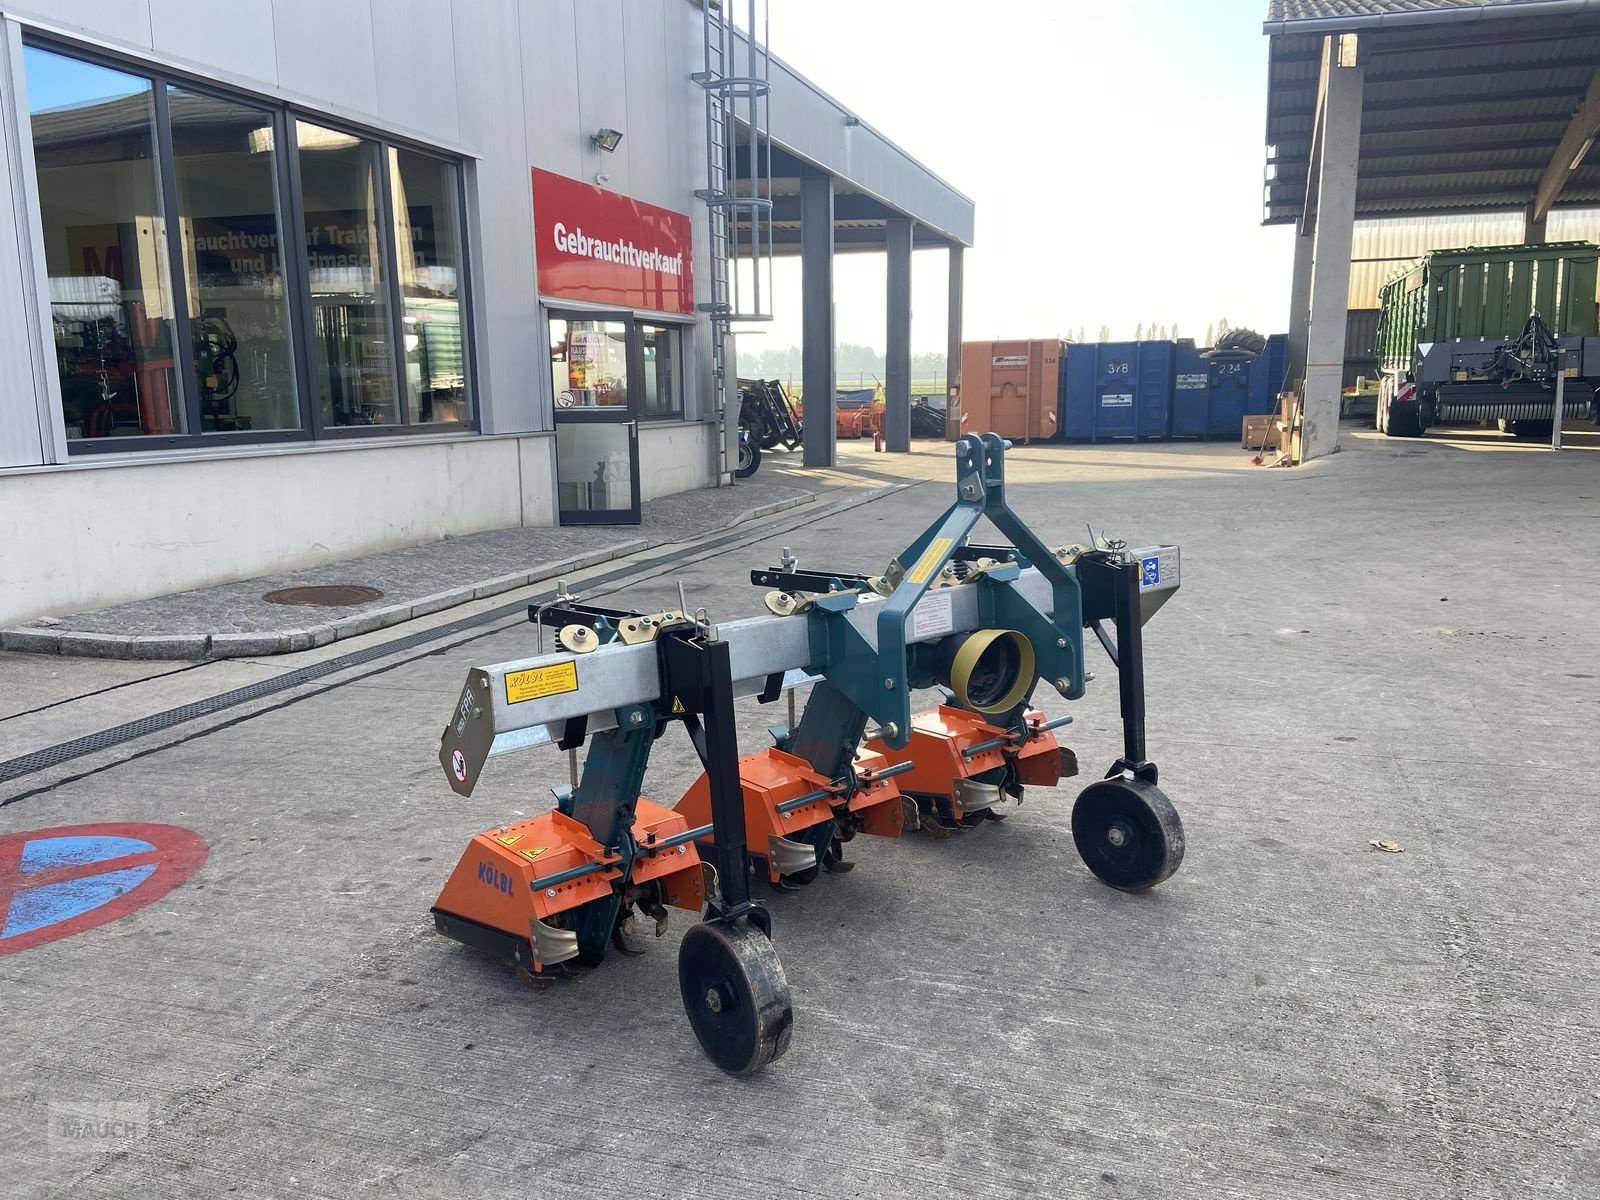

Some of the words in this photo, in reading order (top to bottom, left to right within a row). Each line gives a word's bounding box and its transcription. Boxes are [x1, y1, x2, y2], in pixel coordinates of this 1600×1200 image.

[231, 255, 265, 273] und
[554, 222, 682, 275] Gebrauchtverkauf
[478, 860, 514, 897] KÖLBL
